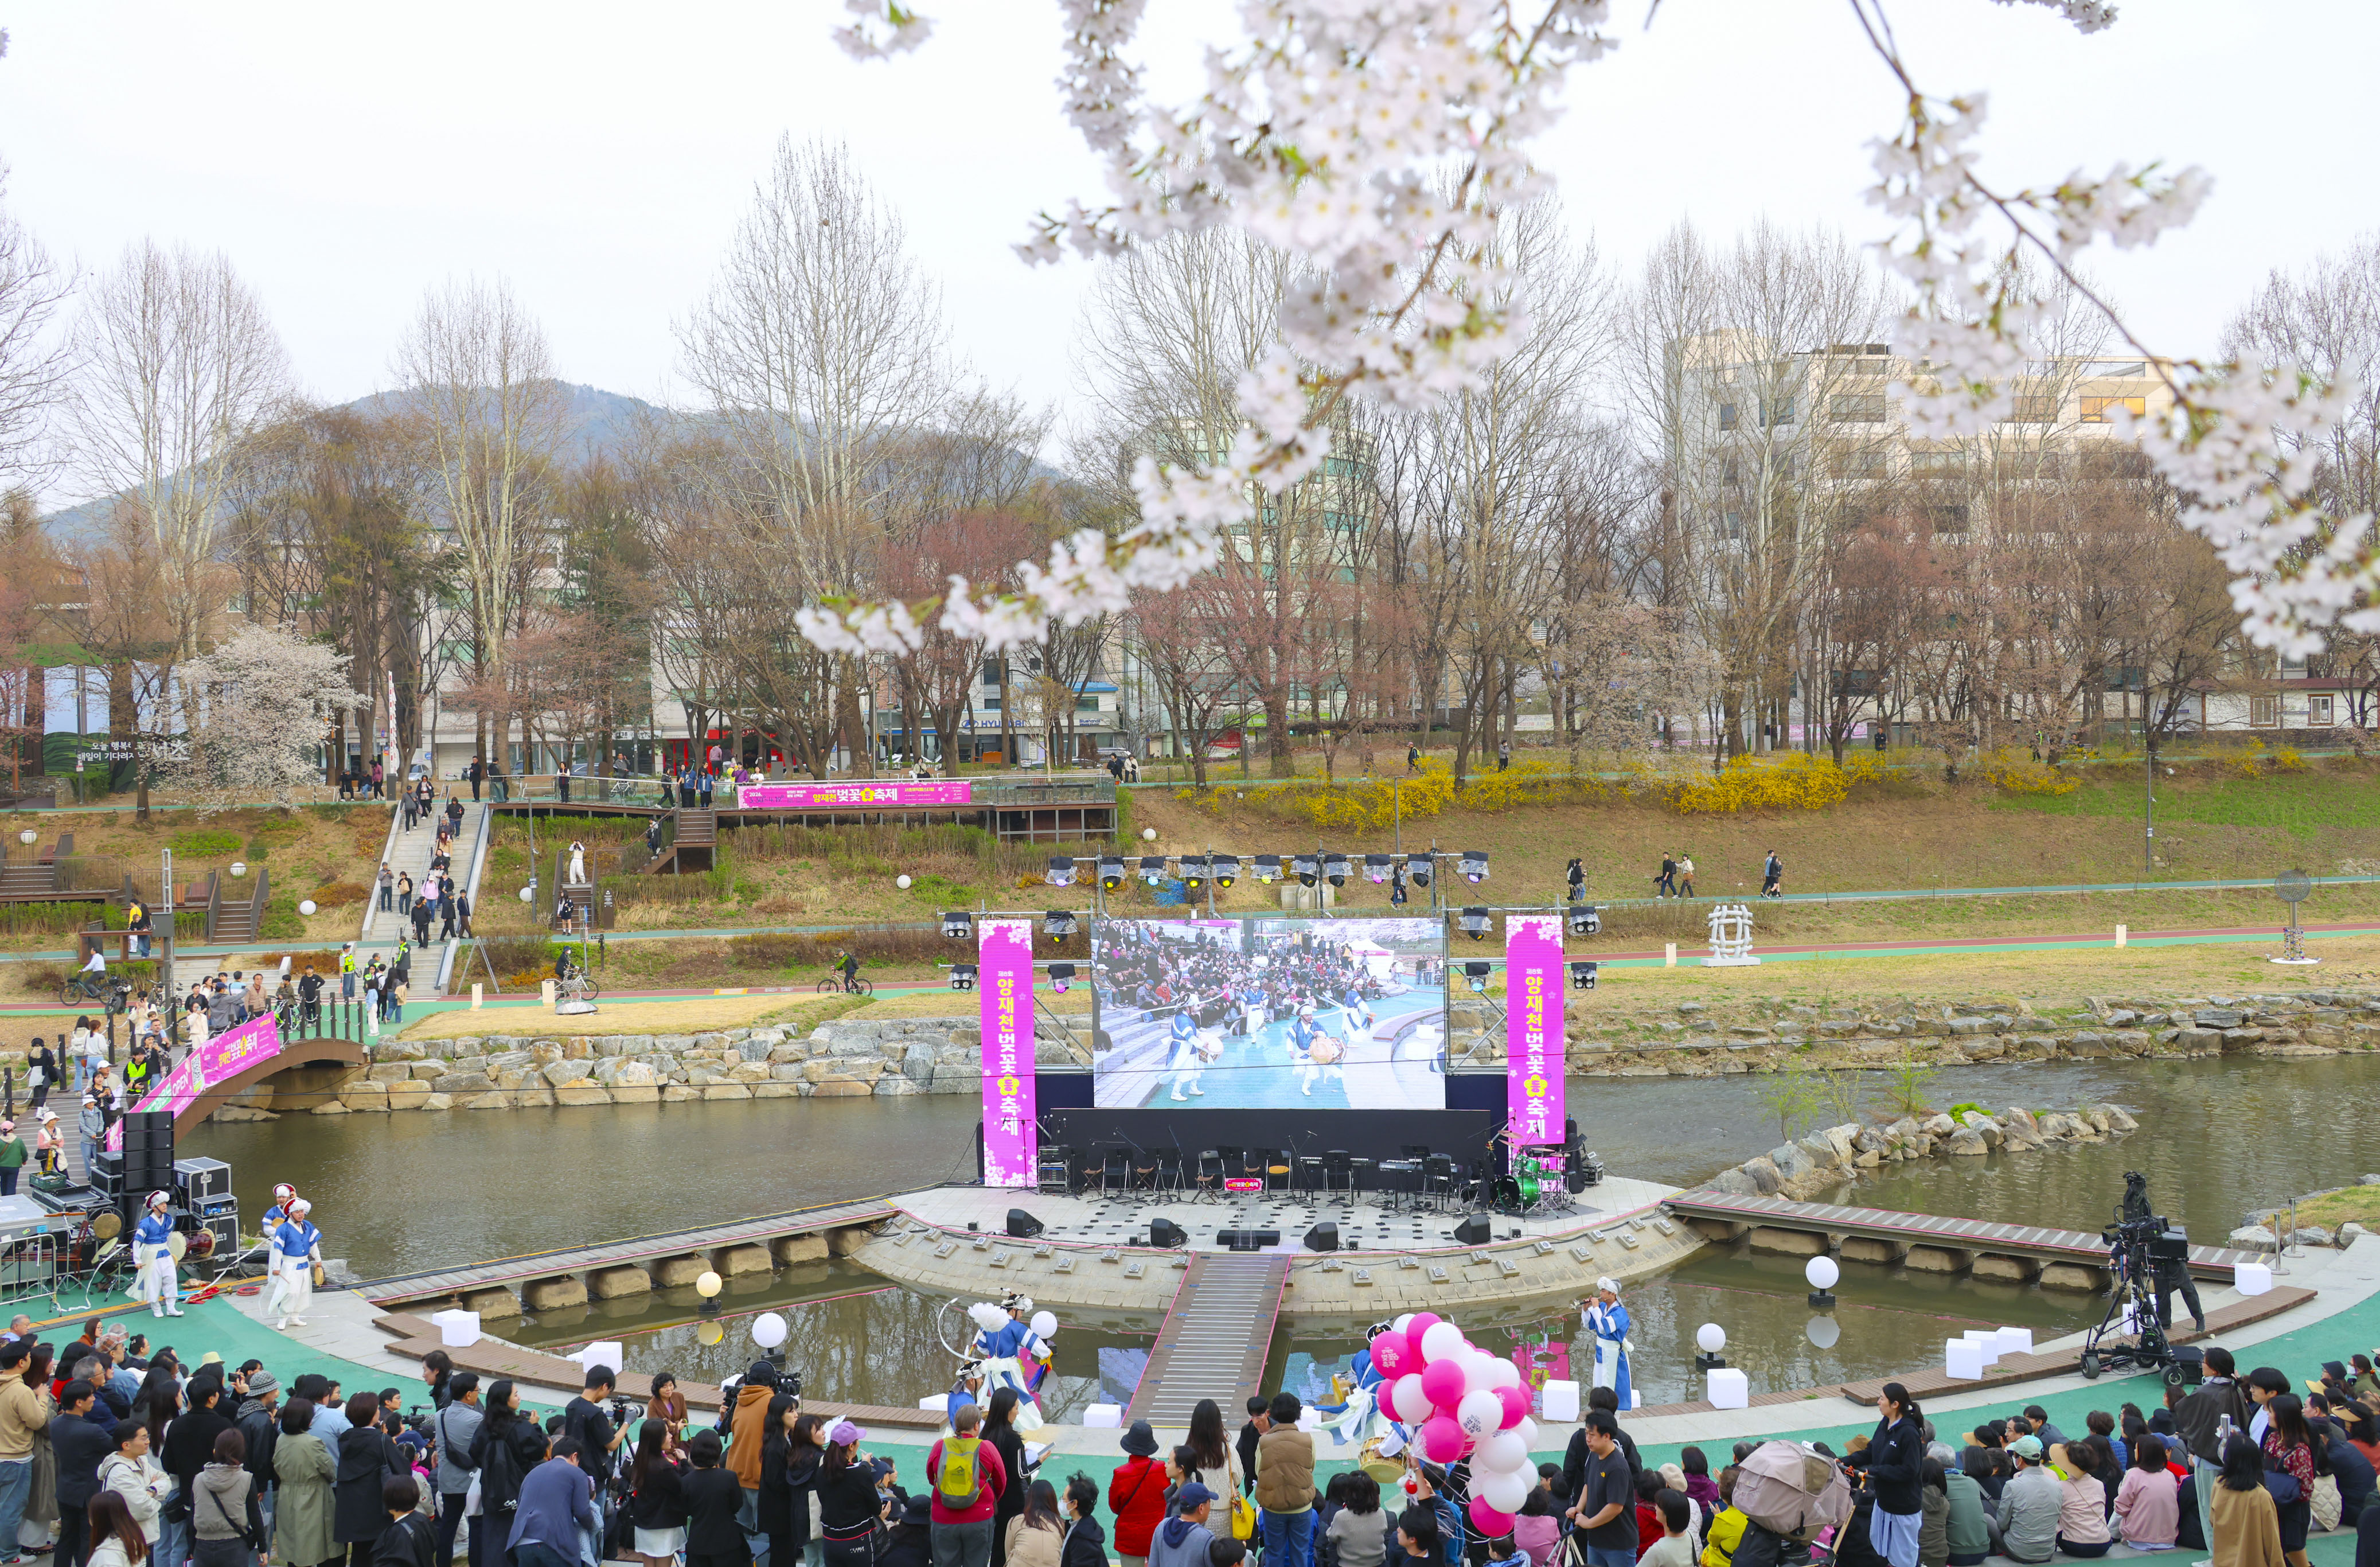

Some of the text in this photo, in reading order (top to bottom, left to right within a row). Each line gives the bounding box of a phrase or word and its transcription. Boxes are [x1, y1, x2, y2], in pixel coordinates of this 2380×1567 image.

[91, 741, 108, 751] 오늘
[813, 793, 837, 803] 양재천
[997, 979, 1015, 1032] 양재천
[1525, 976, 1543, 1032] 양재천
[172, 1072, 189, 1097] OPEN
